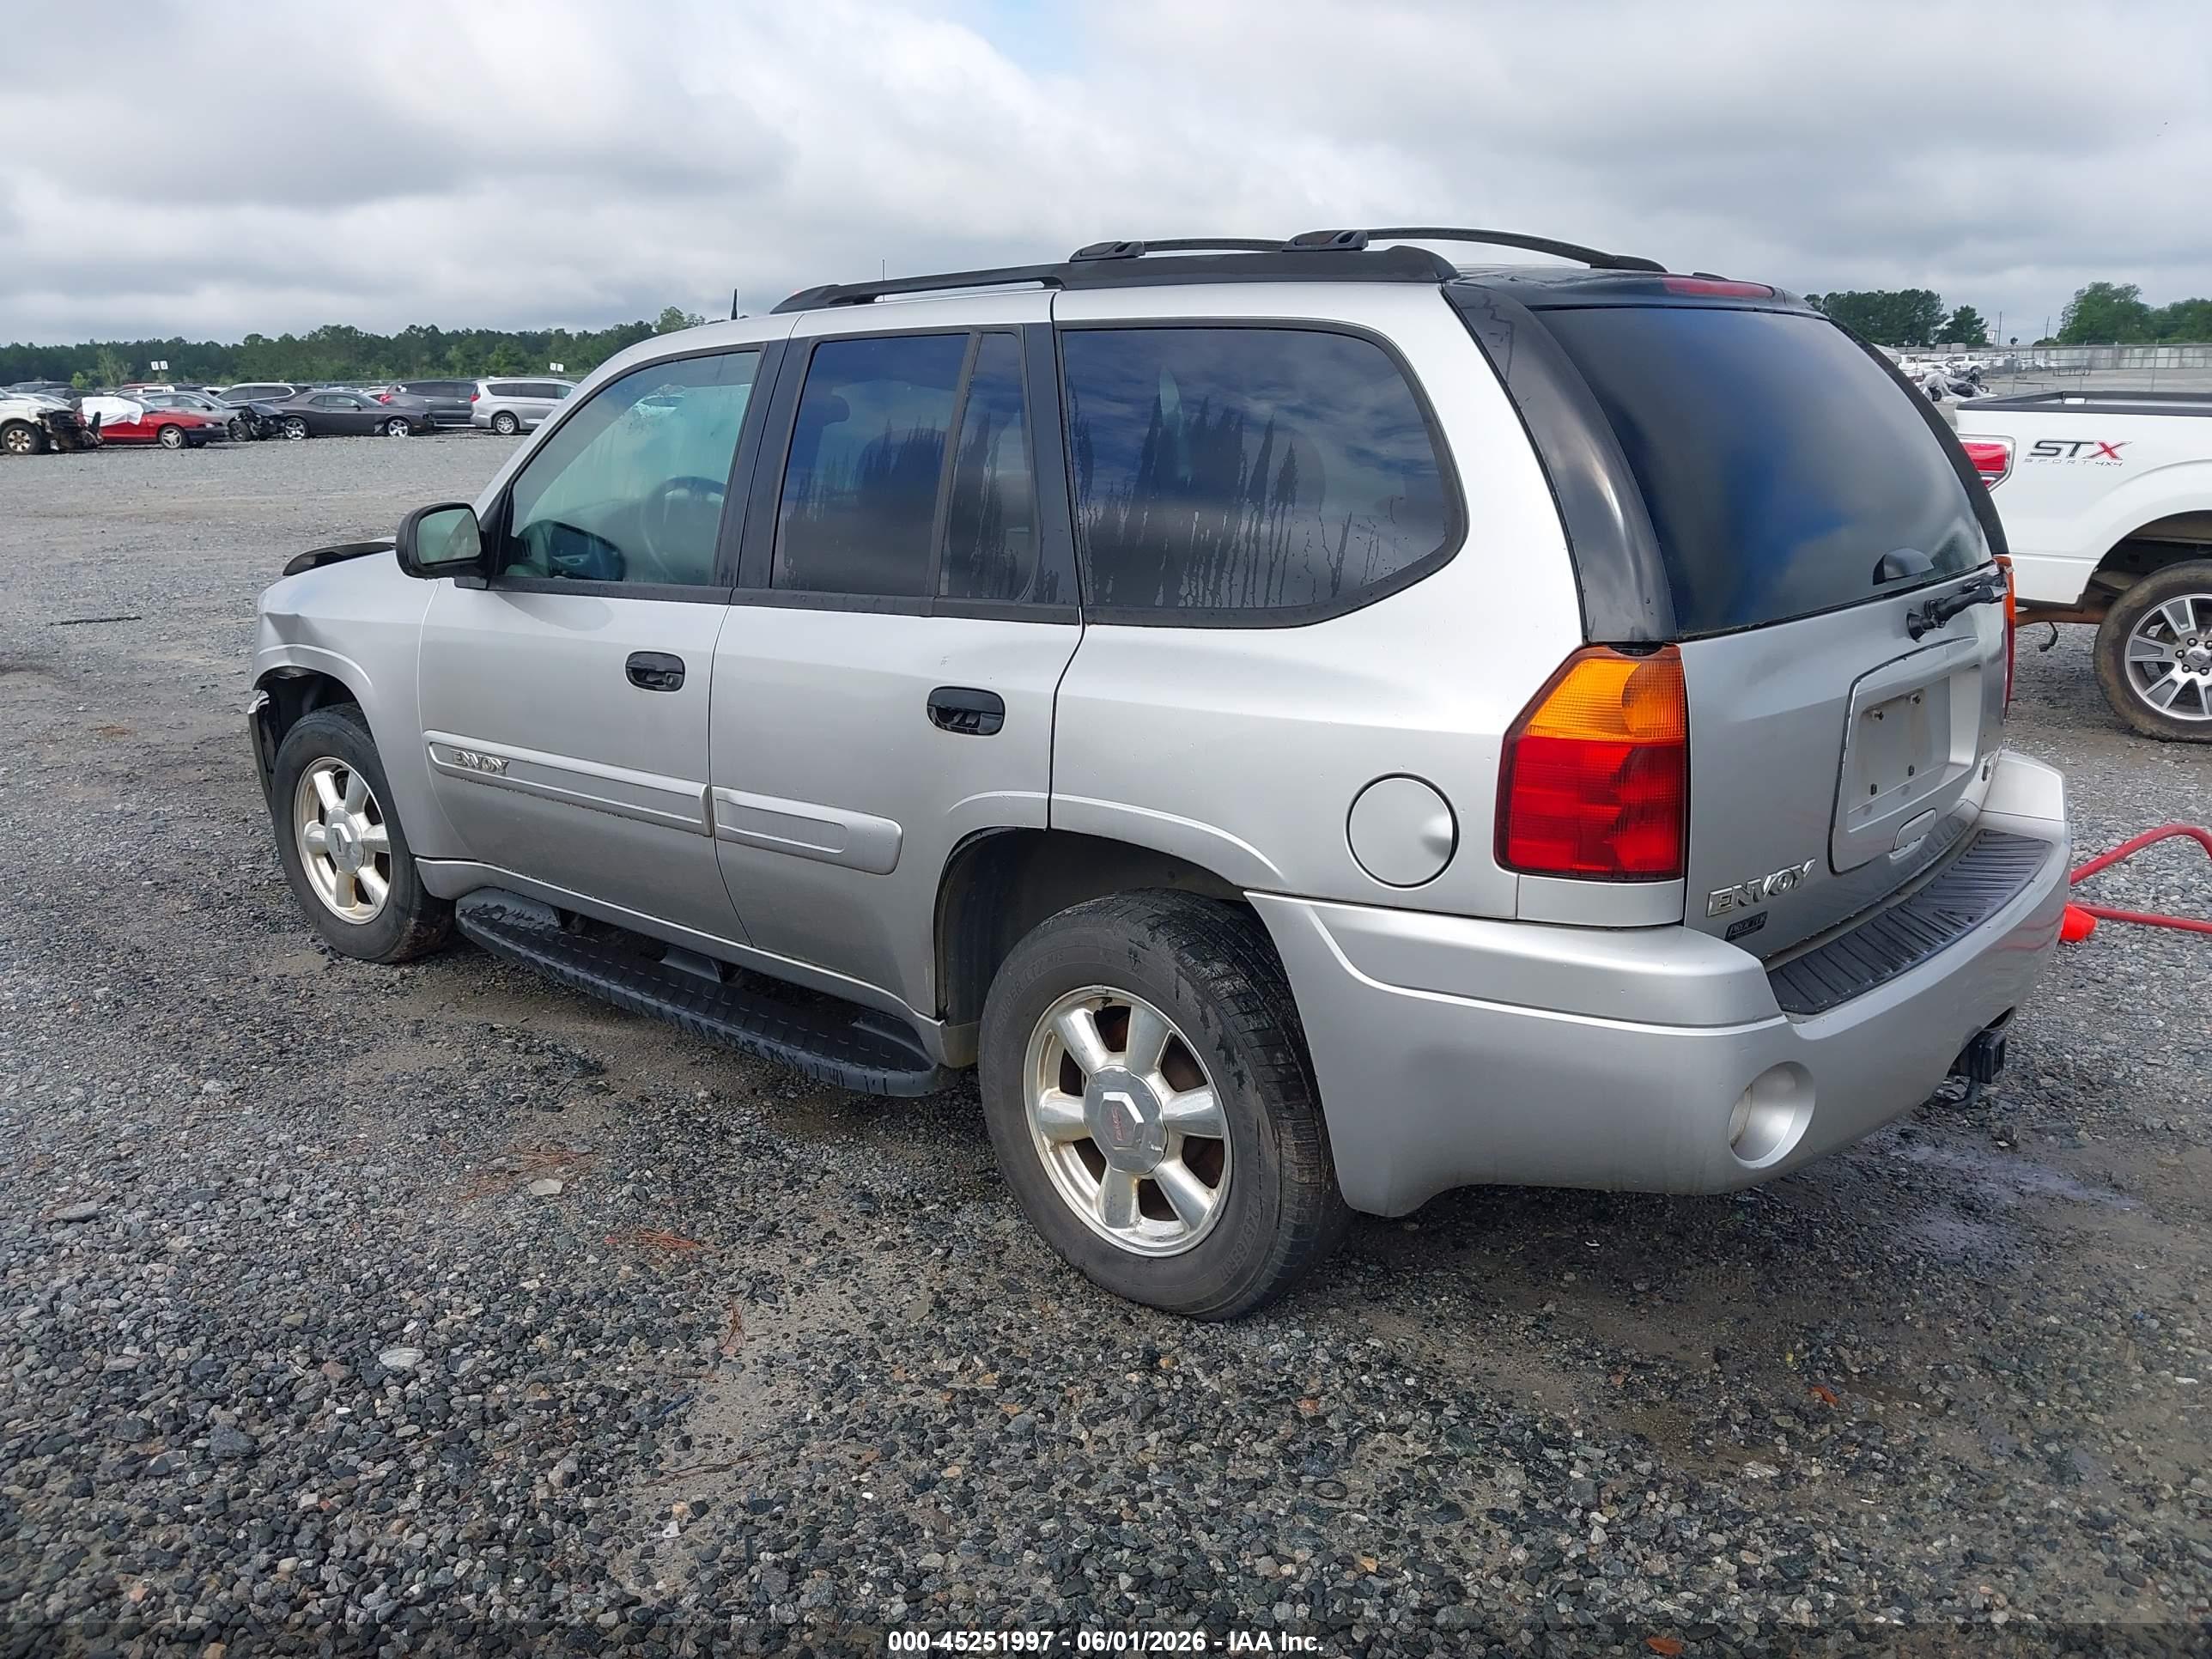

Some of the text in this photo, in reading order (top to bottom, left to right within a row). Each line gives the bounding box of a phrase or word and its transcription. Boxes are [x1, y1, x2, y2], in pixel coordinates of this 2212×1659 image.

[2027, 439, 2133, 460] STX
[450, 748, 510, 776] ENVOY
[1706, 857, 1817, 917] ENVOY
